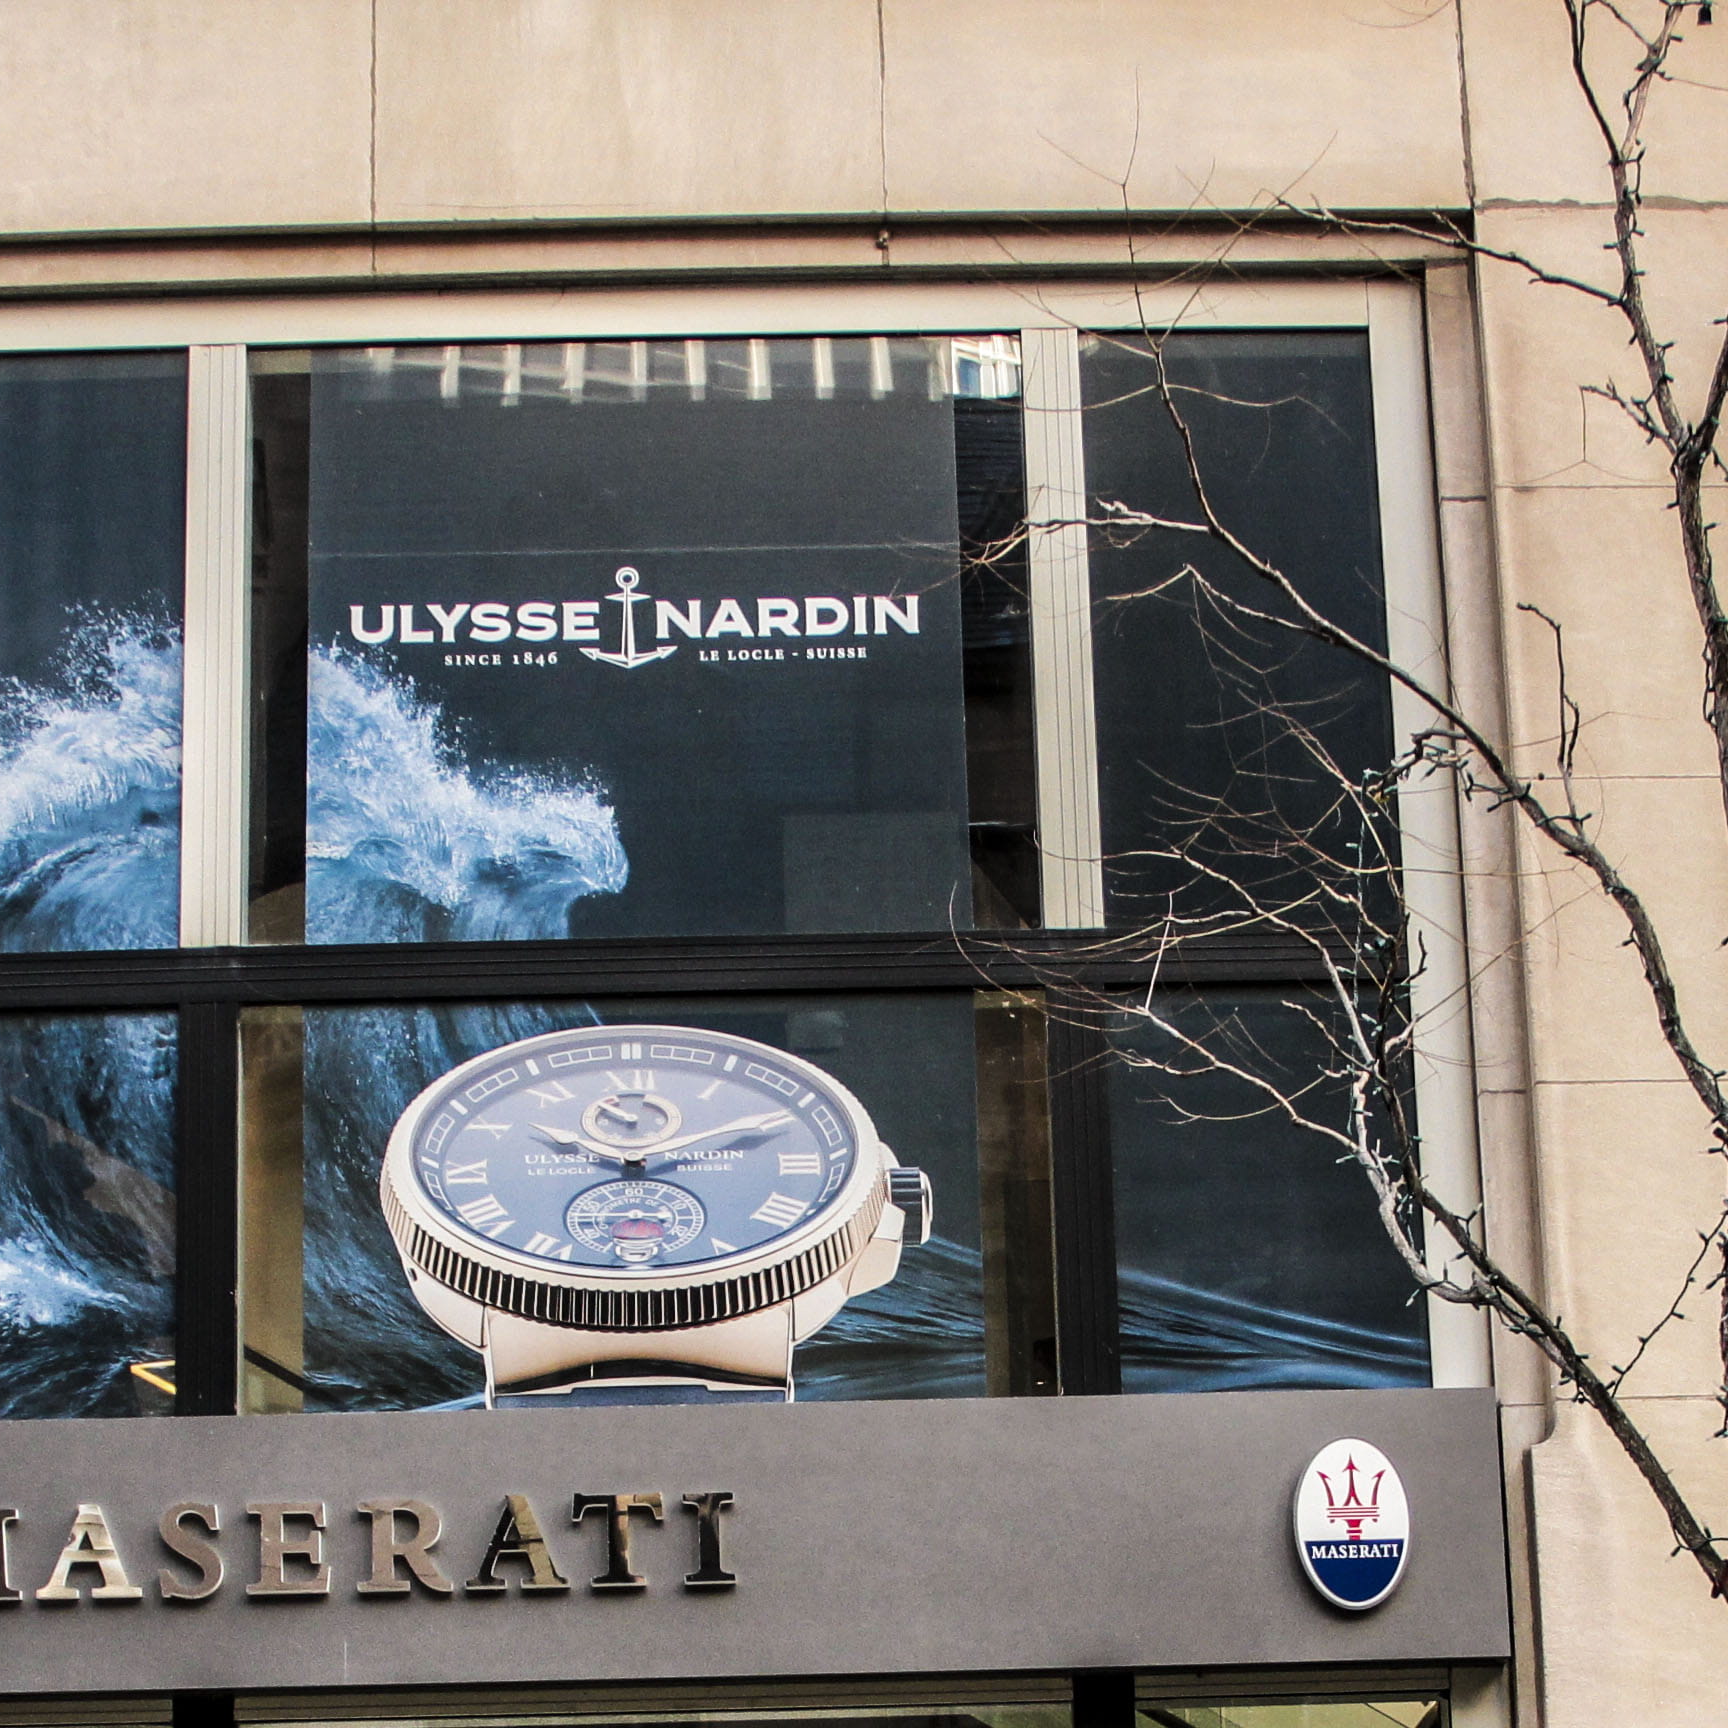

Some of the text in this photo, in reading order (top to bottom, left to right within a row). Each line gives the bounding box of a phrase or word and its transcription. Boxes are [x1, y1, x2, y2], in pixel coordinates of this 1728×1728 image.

[349, 595, 921, 645] ULYSSE NARDIN
[444, 651, 559, 668] SINCE 1846
[699, 649, 720, 662] LE
[727, 648, 785, 662] LOCLE
[806, 646, 868, 660] SUISSE
[524, 1149, 744, 1165] ULYSSE NARDIN
[527, 1163, 733, 1177] LE LOCLE SUISSE
[624, 1187, 644, 1196] 60
[1311, 1543, 1400, 1560] MASERATI
